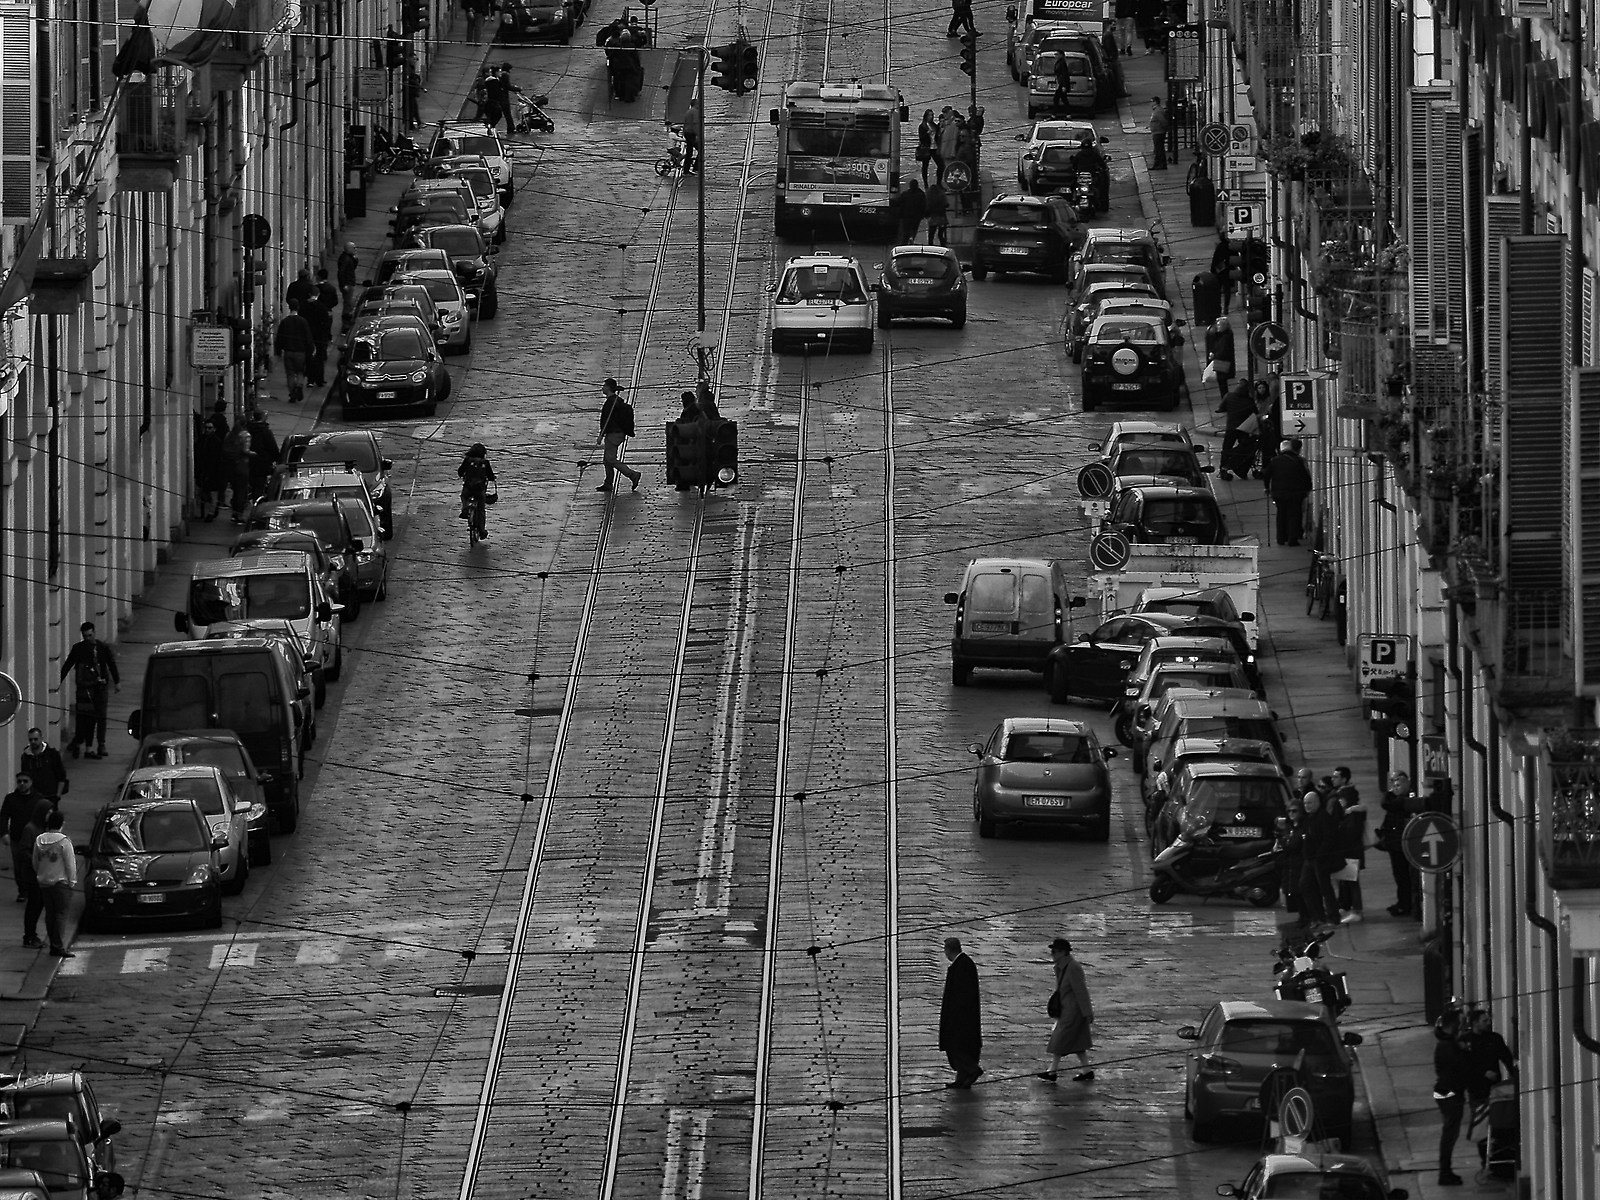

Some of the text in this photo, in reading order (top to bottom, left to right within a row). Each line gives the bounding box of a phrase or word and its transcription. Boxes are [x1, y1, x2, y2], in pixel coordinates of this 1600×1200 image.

[1238, 209, 1249, 222] P
[1292, 382, 1305, 400] P
[1376, 643, 1391, 661] P
[1423, 743, 1447, 772] Park
